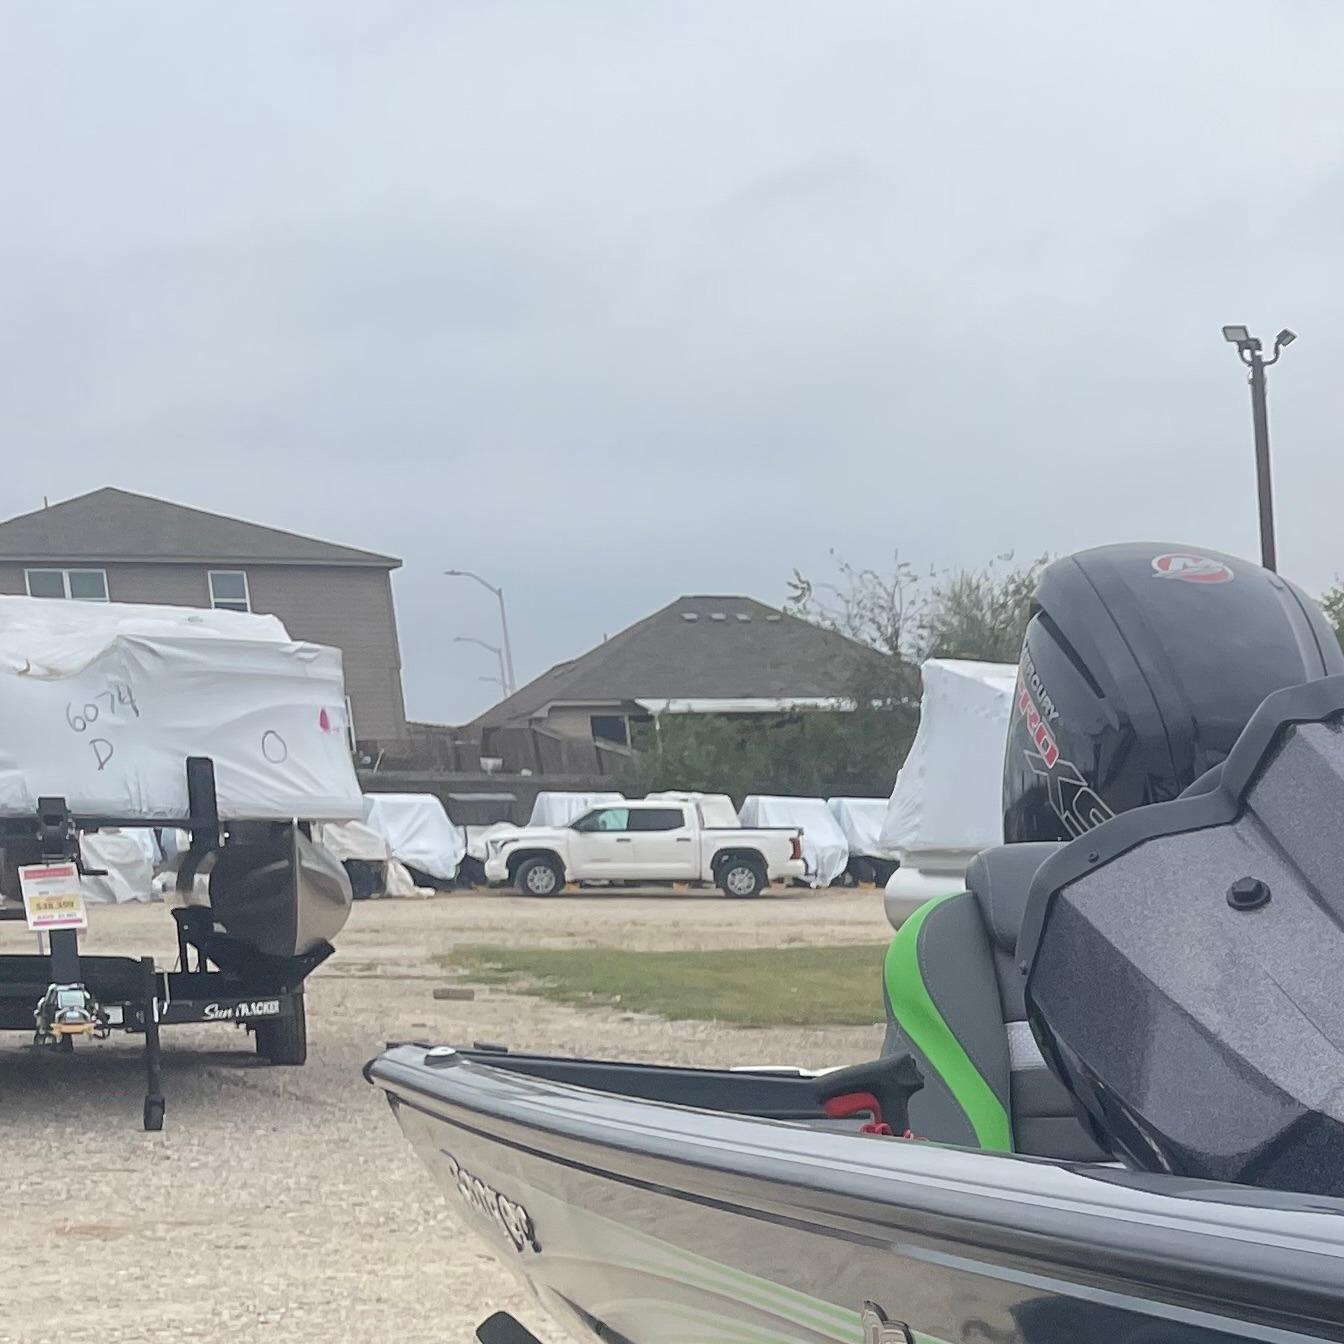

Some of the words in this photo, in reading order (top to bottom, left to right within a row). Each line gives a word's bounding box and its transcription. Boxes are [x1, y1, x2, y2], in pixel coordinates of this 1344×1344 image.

[66, 684, 140, 732] 6074
[89, 738, 114, 771] D
[202, 1003, 234, 1020] Sun
